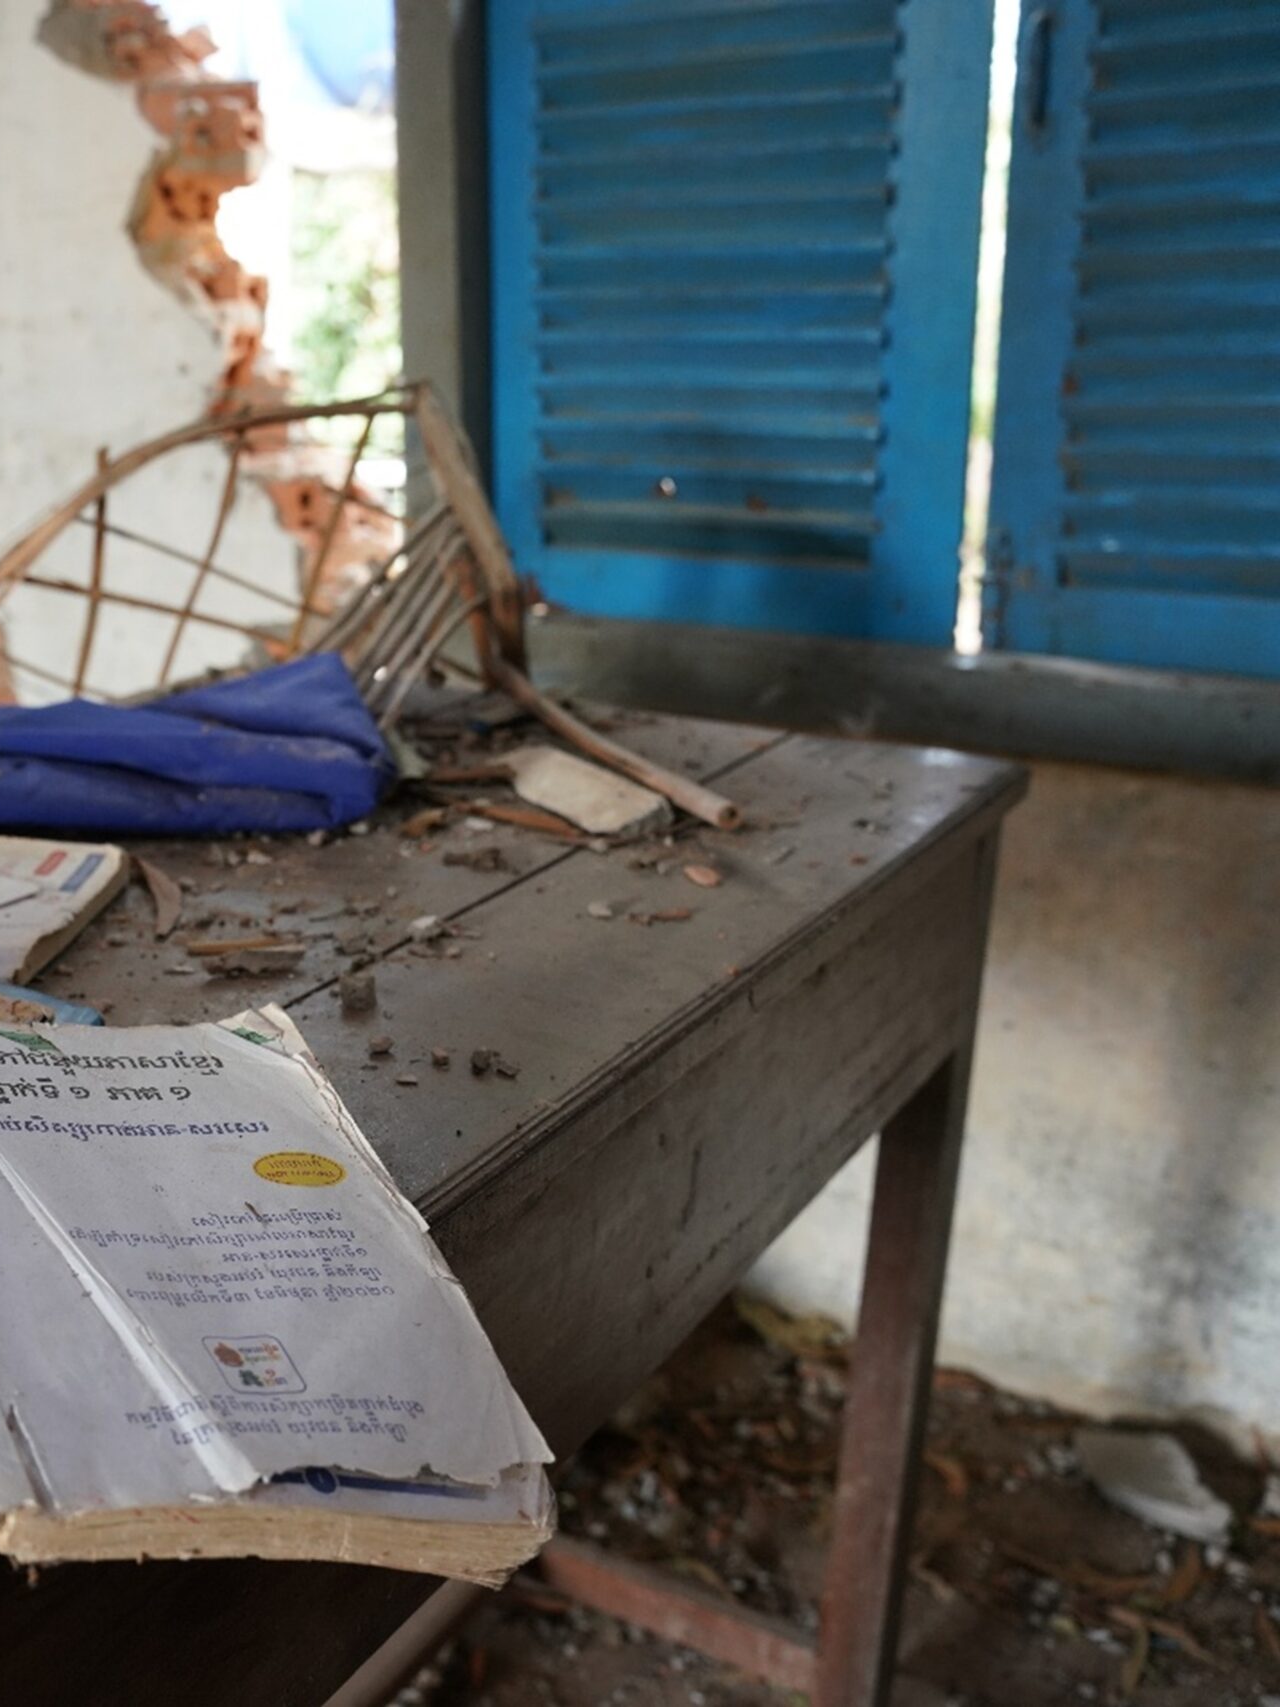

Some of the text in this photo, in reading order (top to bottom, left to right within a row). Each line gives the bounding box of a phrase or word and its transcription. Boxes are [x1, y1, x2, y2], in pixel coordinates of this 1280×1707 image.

[70, 1086, 90, 1099] ១
[106, 1086, 164, 1101] ភាគ
[170, 1086, 191, 1100] ១
